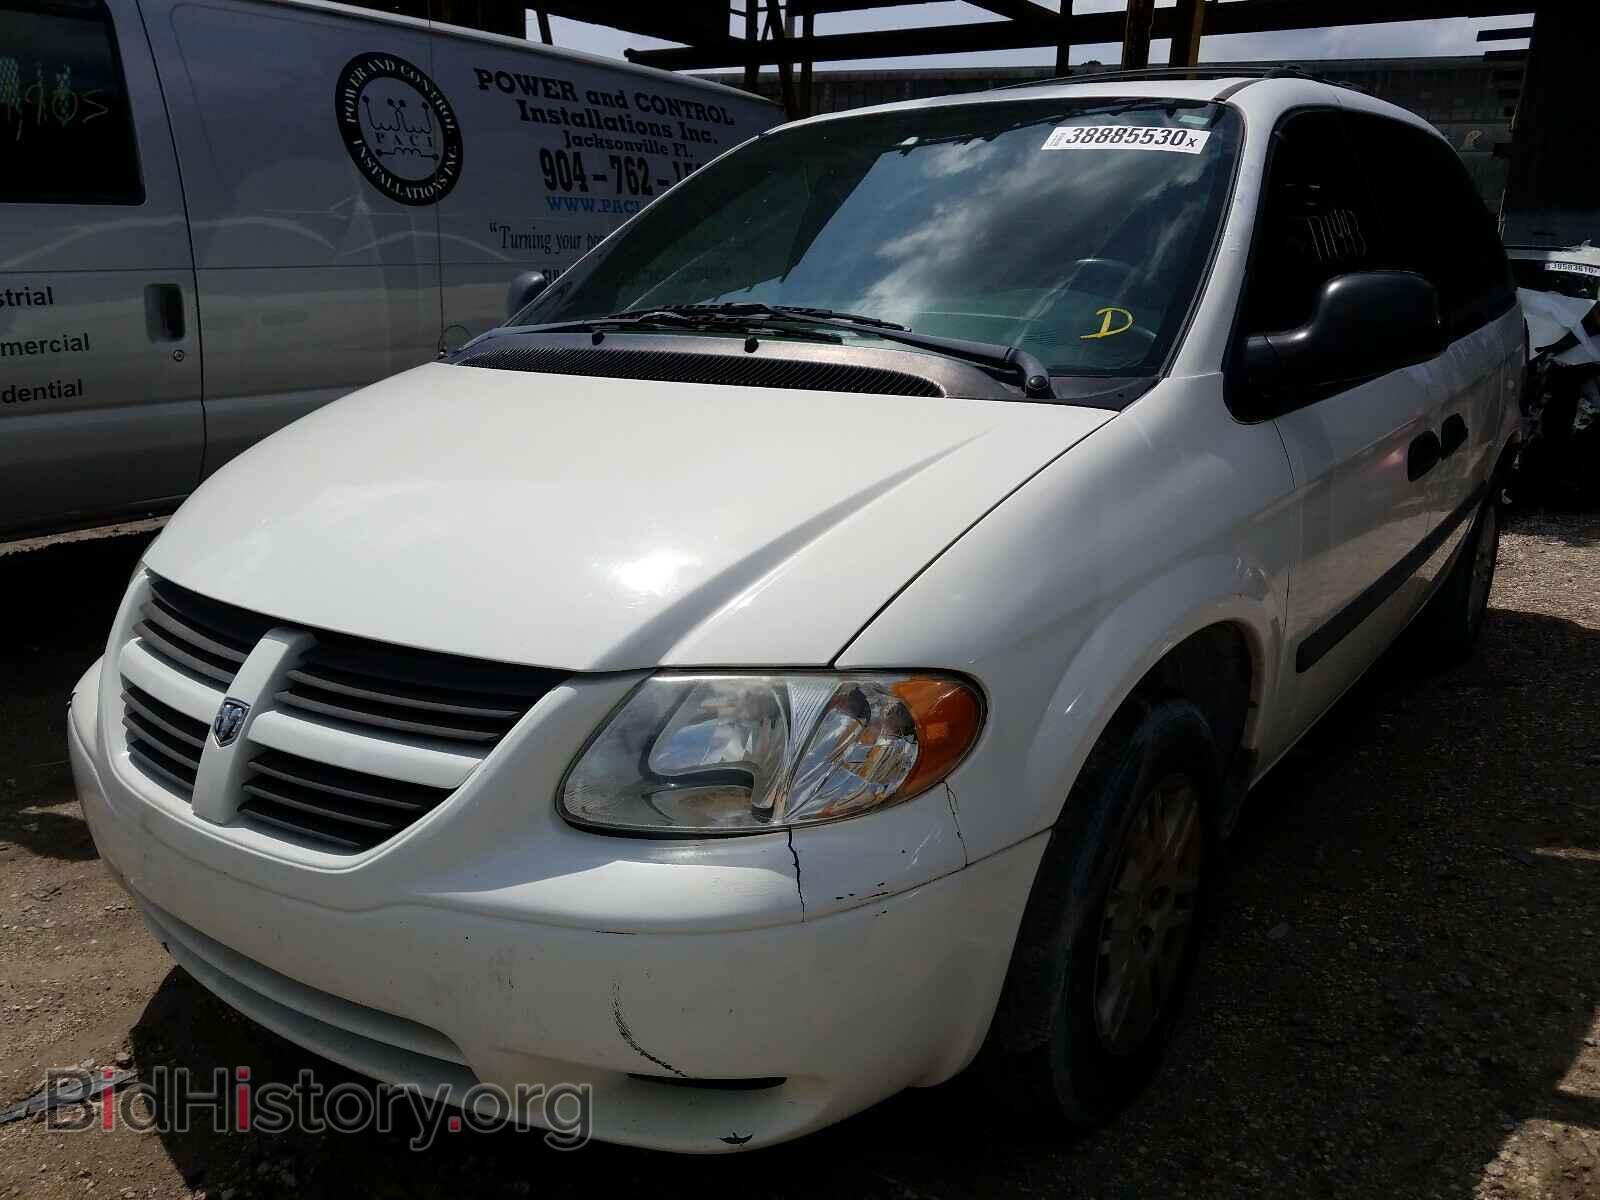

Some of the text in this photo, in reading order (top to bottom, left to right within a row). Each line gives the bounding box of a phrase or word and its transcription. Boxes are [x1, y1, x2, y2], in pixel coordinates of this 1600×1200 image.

[473, 68, 735, 126] POWER and CONTROL
[517, 99, 719, 145] Installations Inc.
[561, 130, 695, 158] Jacksonville Fl.
[554, 233, 582, 254] your
[1081, 308, 1134, 339] D
